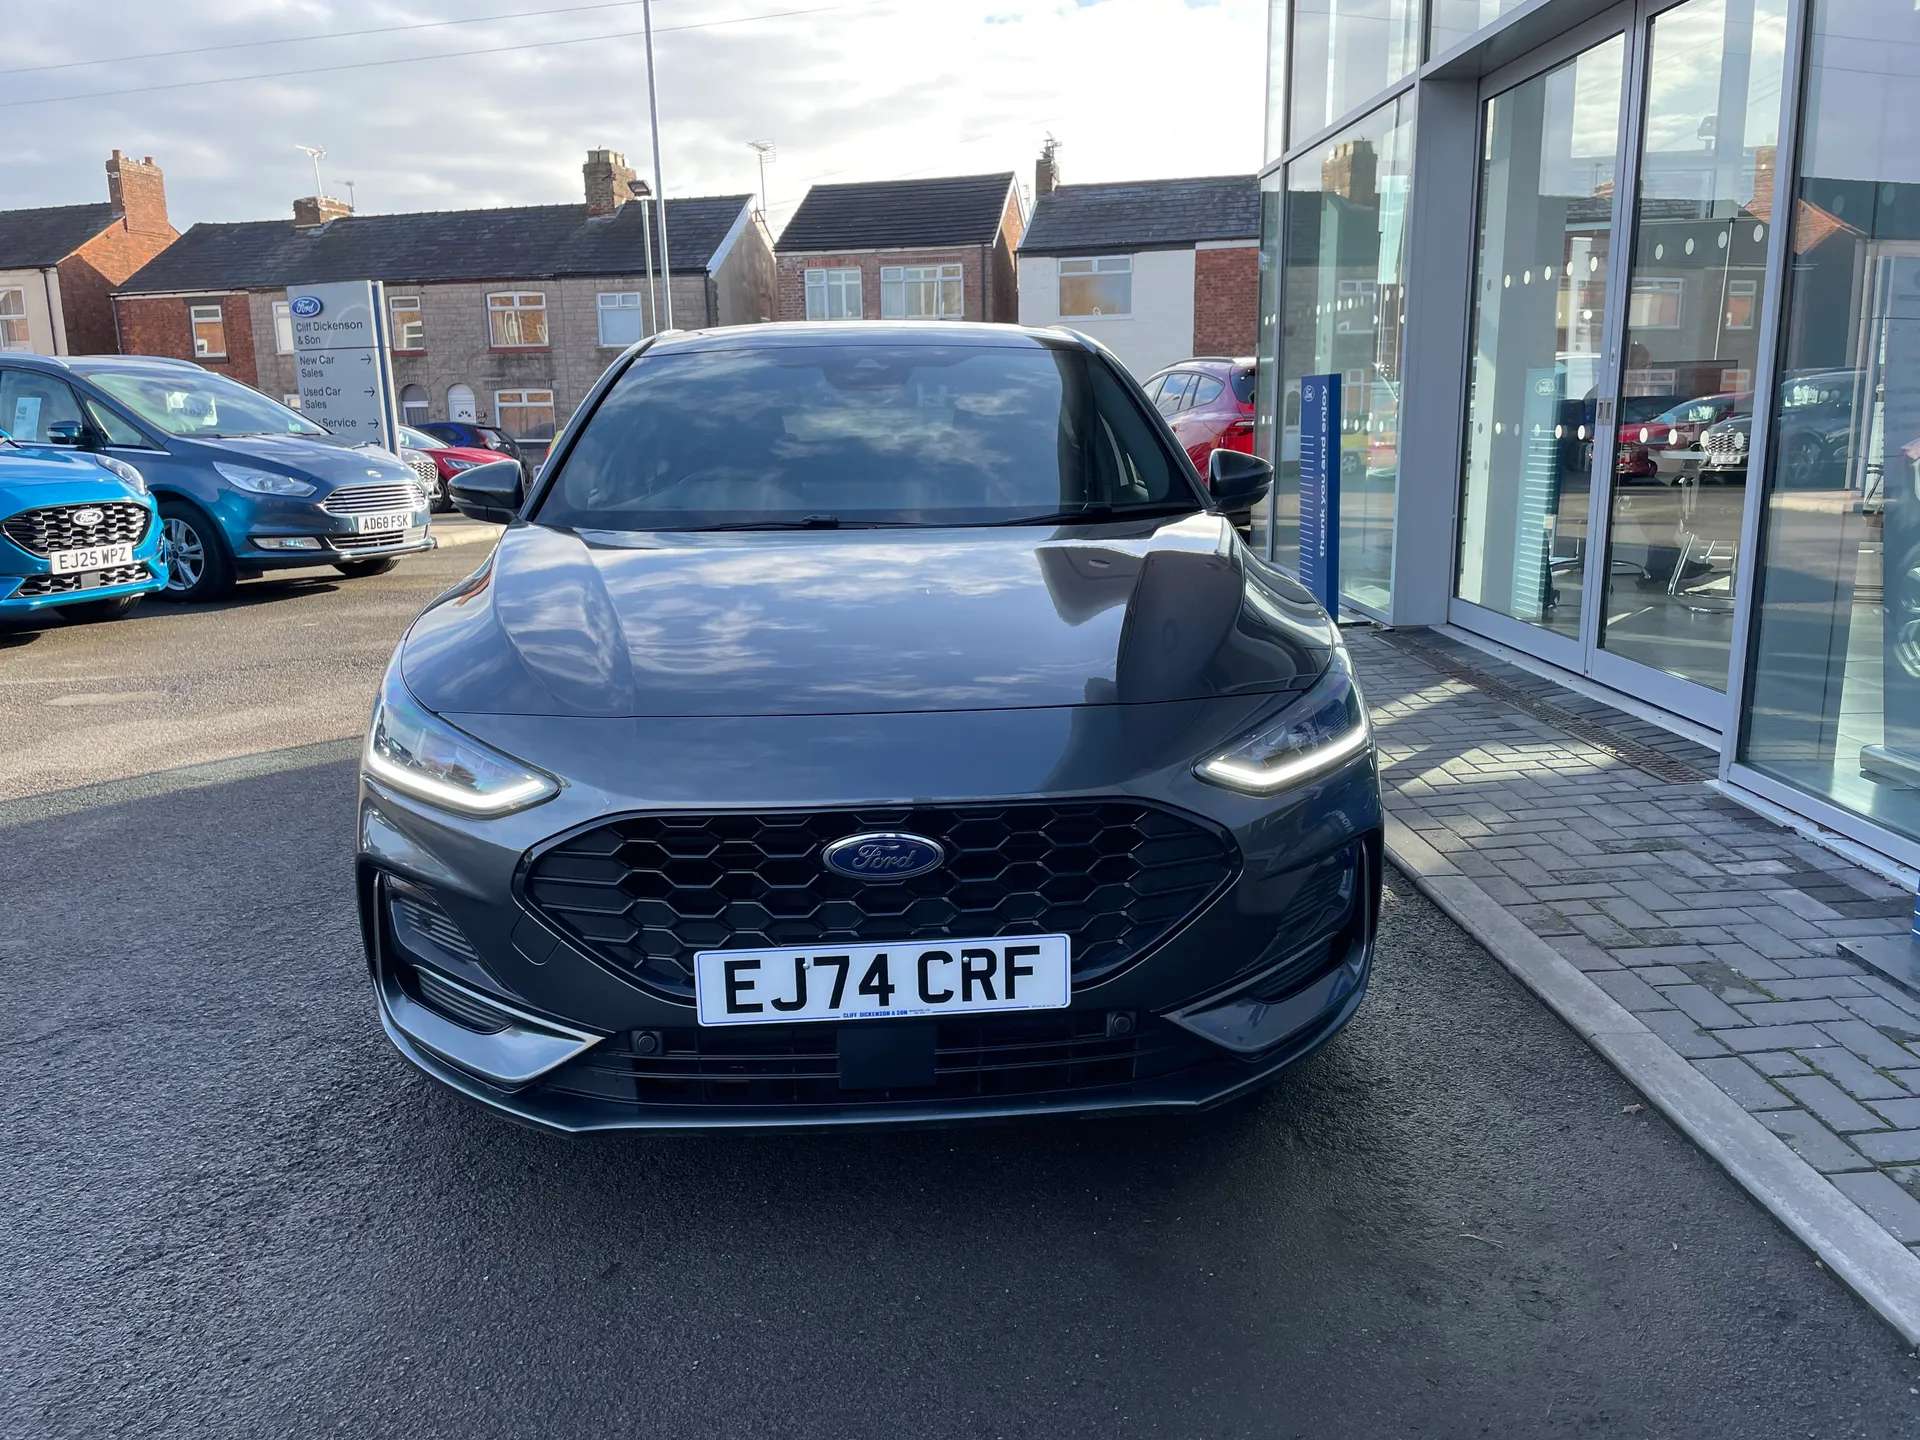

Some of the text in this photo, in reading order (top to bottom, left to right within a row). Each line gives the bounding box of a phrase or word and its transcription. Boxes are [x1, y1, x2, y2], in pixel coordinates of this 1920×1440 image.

[313, 321, 363, 332] Dickenson
[298, 335, 321, 345] & Son
[300, 355, 335, 366] New Car
[301, 368, 324, 378] Sales
[303, 386, 341, 397] Used Car
[305, 400, 327, 409] Sales
[1320, 385, 1328, 433] enjoy
[322, 417, 357, 428] Service
[363, 513, 409, 531] AD68 FSK
[59, 547, 127, 570] EJ25 WPZ
[851, 843, 919, 871] Ford
[723, 945, 1041, 1014] EJ74 CRF
